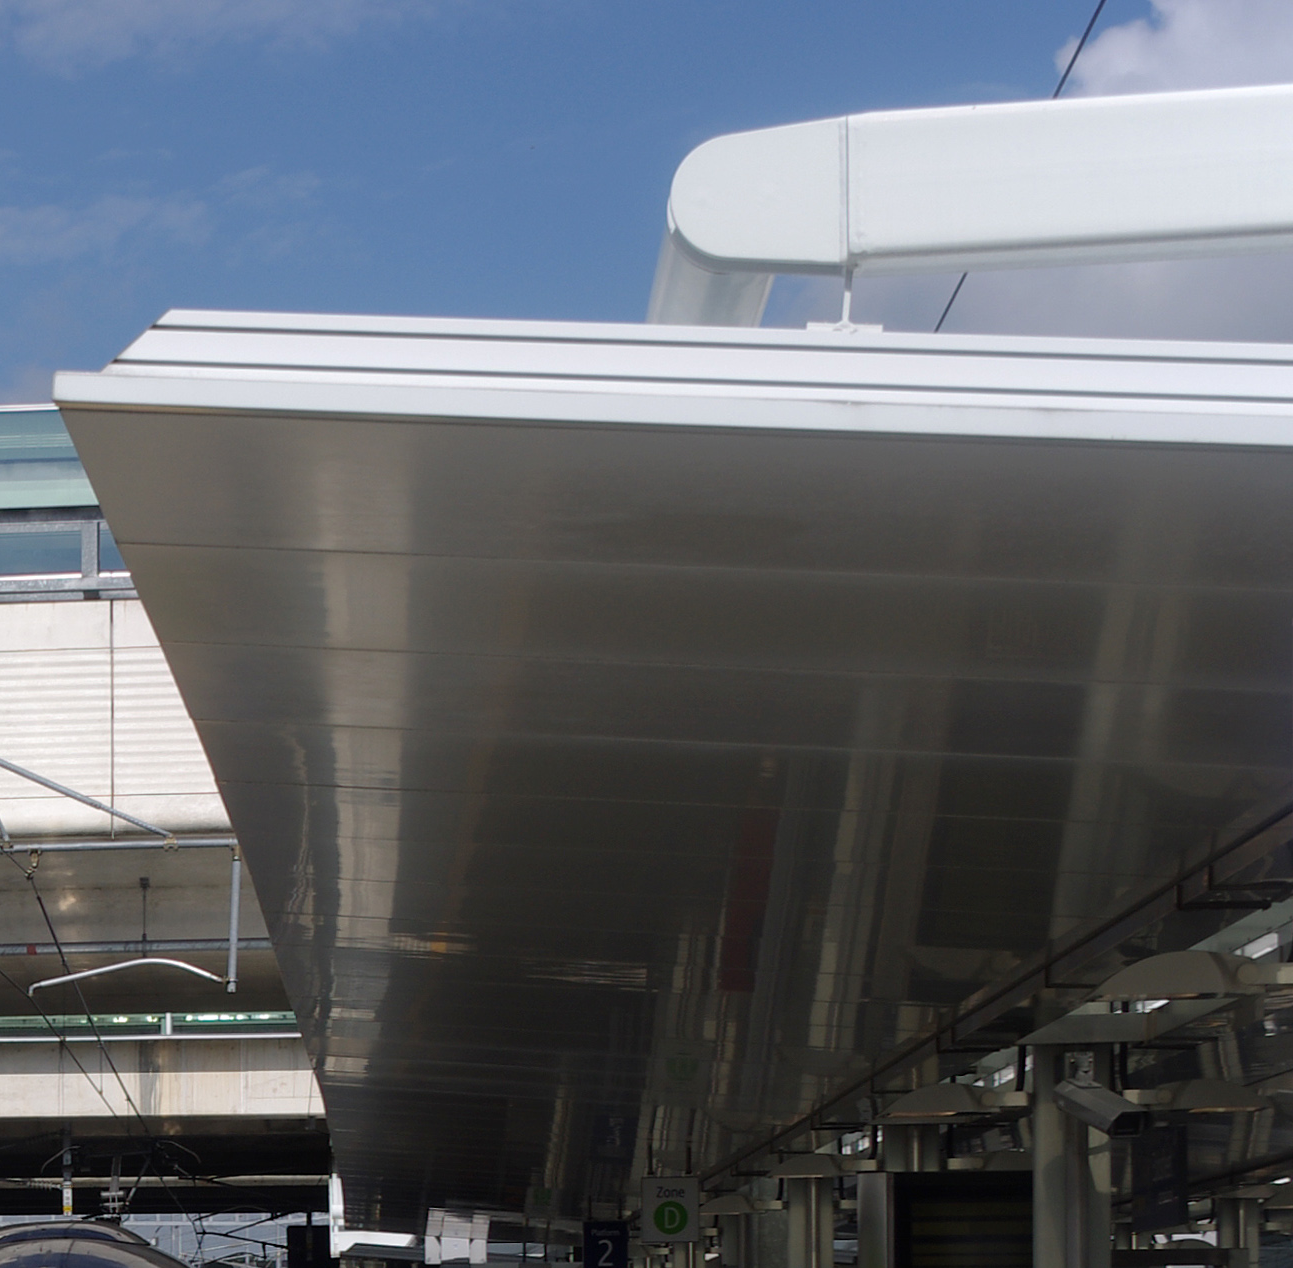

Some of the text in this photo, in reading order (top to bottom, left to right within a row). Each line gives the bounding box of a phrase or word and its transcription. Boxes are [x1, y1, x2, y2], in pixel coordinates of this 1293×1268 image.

[656, 1186, 685, 1198] Zone
[664, 1206, 681, 1229] D
[591, 1228, 621, 1237] Platform
[597, 1239, 614, 1267] 2
